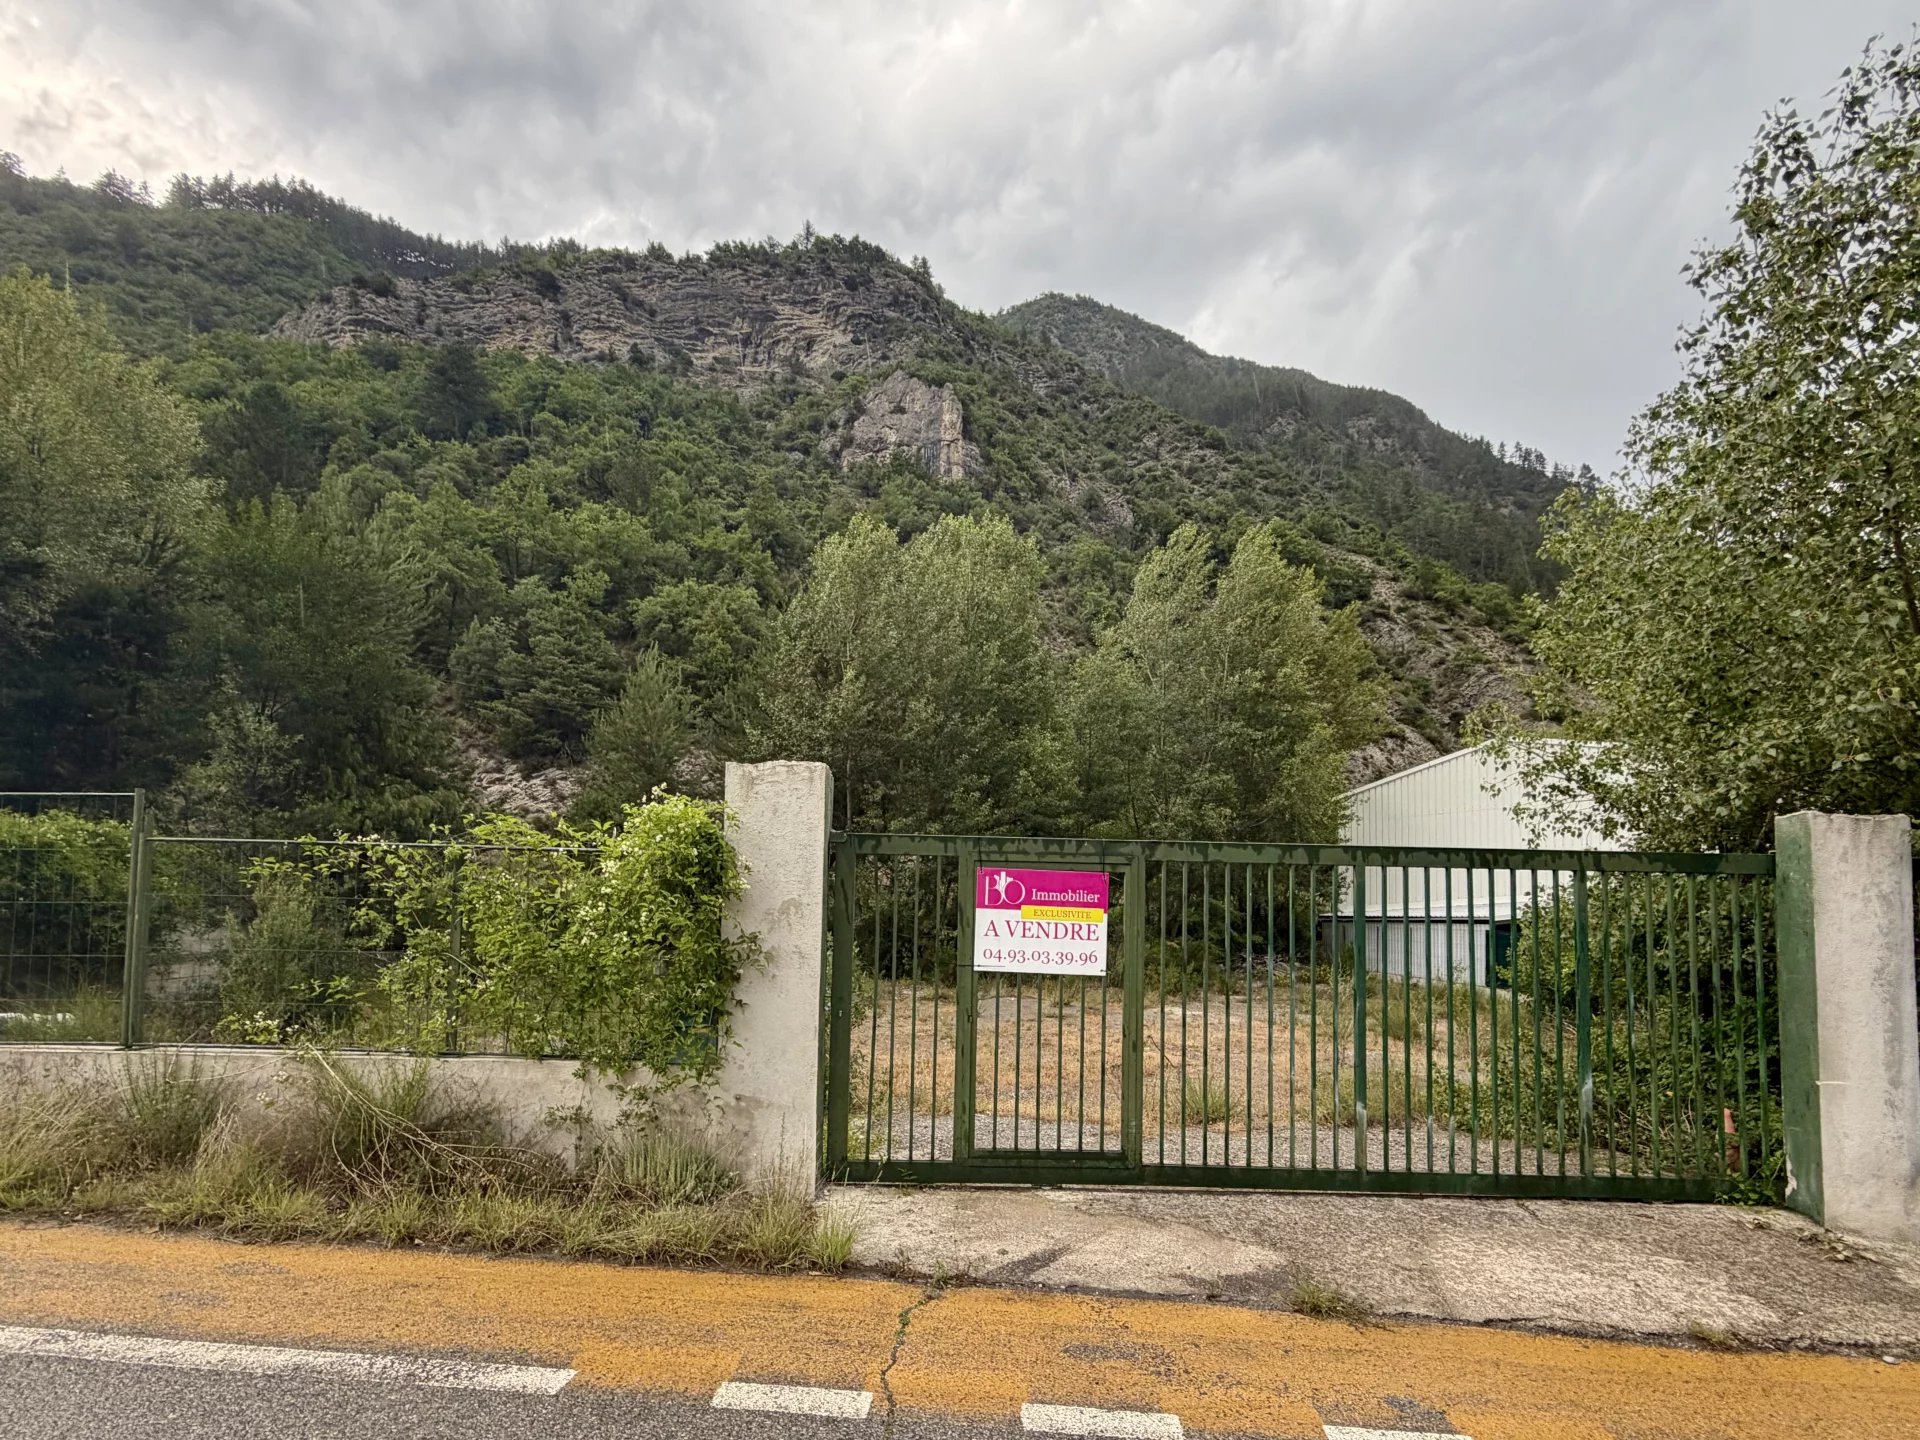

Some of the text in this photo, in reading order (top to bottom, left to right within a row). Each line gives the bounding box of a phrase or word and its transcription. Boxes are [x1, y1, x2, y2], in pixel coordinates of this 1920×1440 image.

[1031, 888, 1101, 903] Immobilier
[1033, 909, 1092, 919] EXCLUSIVITE
[983, 919, 1100, 941] A VENDRE
[983, 948, 1098, 966] 04.93.03.39.96
